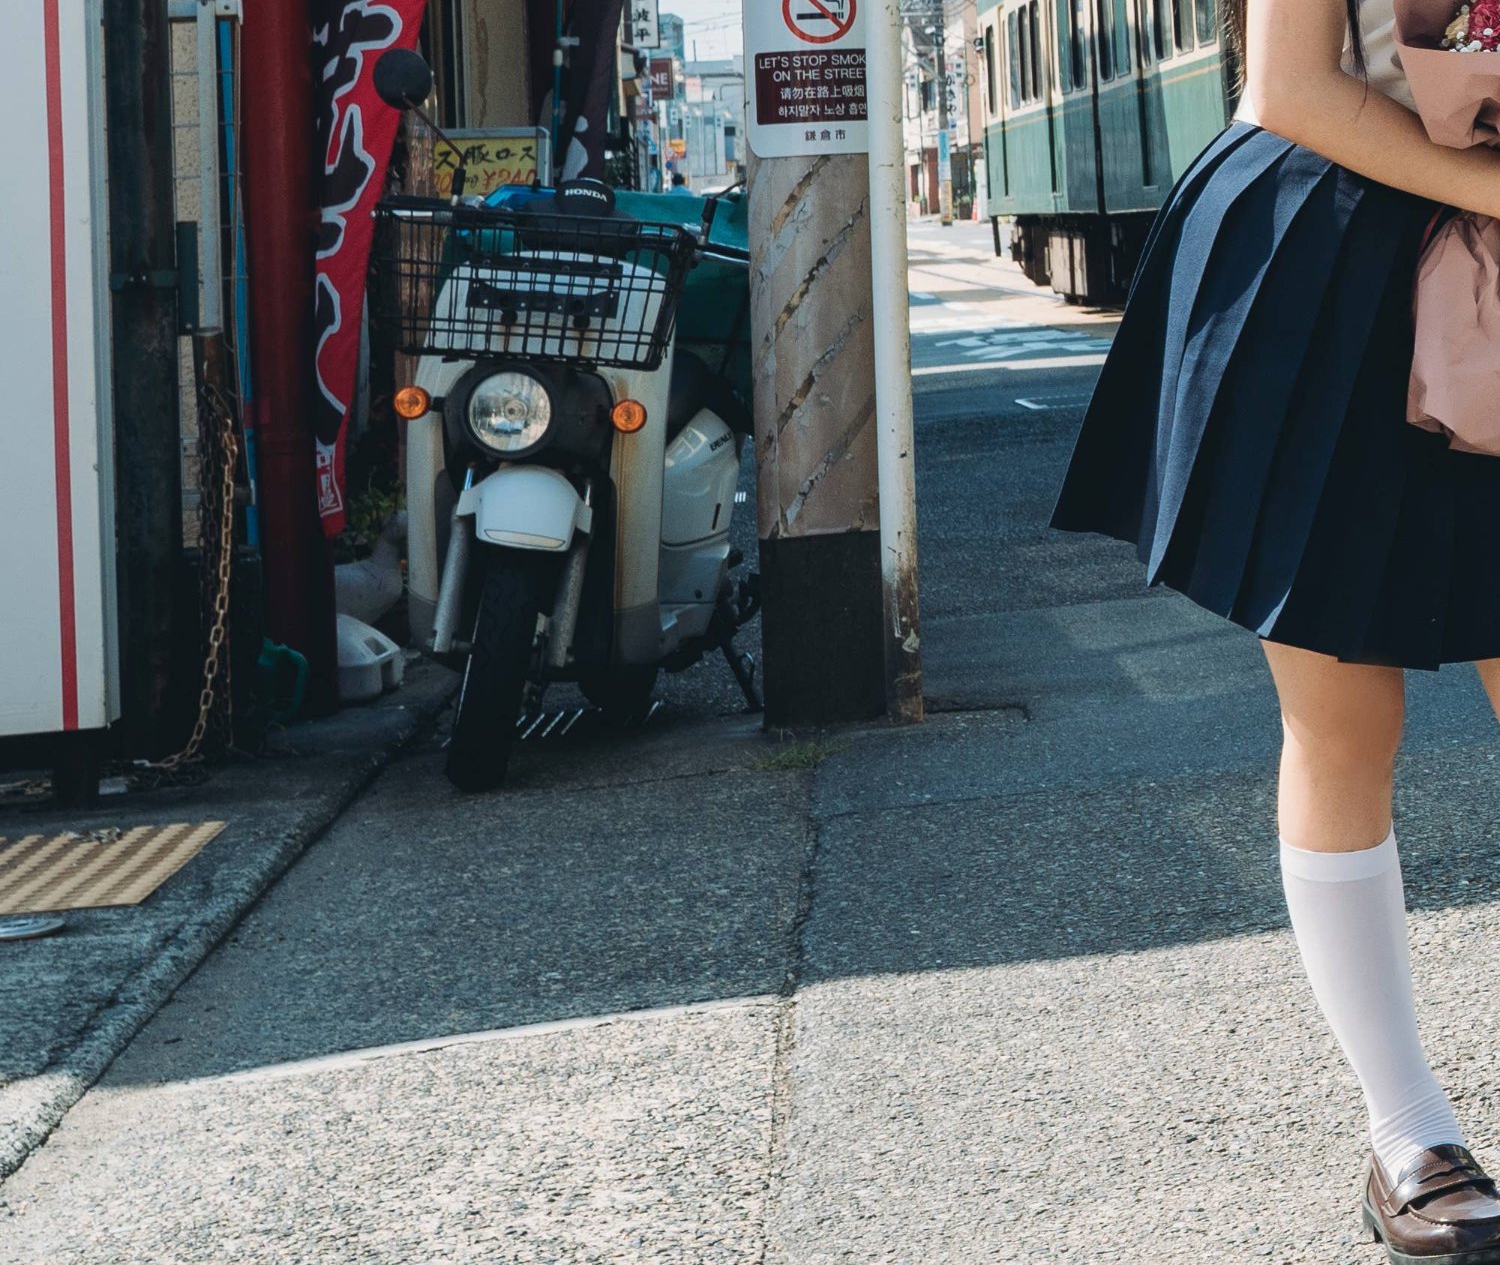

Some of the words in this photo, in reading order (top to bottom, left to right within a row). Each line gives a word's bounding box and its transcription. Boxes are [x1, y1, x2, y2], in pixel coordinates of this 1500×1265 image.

[759, 56, 789, 69] LET'S
[793, 54, 828, 67] STOP
[773, 70, 791, 82] ON
[794, 69, 820, 81] THE
[780, 84, 865, 100] 请勿在路上吸烟
[778, 105, 820, 118] 하지말자
[824, 103, 845, 116] 노상
[805, 129, 846, 142] 鎌倉市
[565, 187, 608, 203] HONDA
